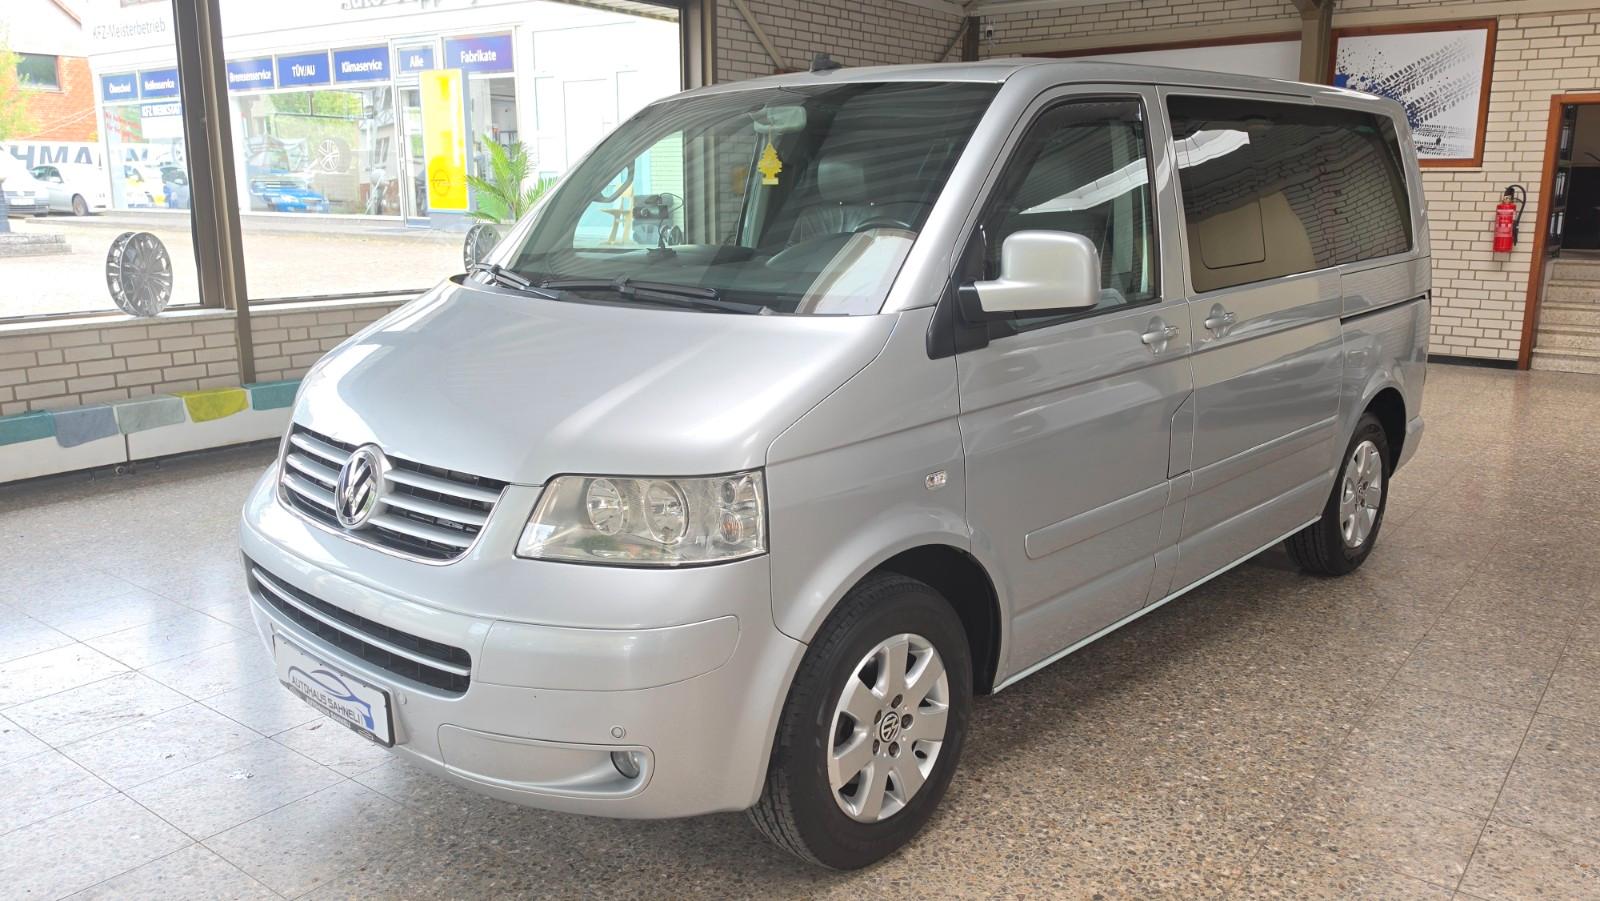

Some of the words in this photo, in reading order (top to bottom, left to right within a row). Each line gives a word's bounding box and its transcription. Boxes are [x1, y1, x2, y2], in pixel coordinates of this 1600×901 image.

[409, 54, 424, 68] Alle
[460, 49, 497, 64] Fabrikate
[341, 58, 383, 74] Klimaservice
[291, 675, 328, 706] AUTOHAUS
